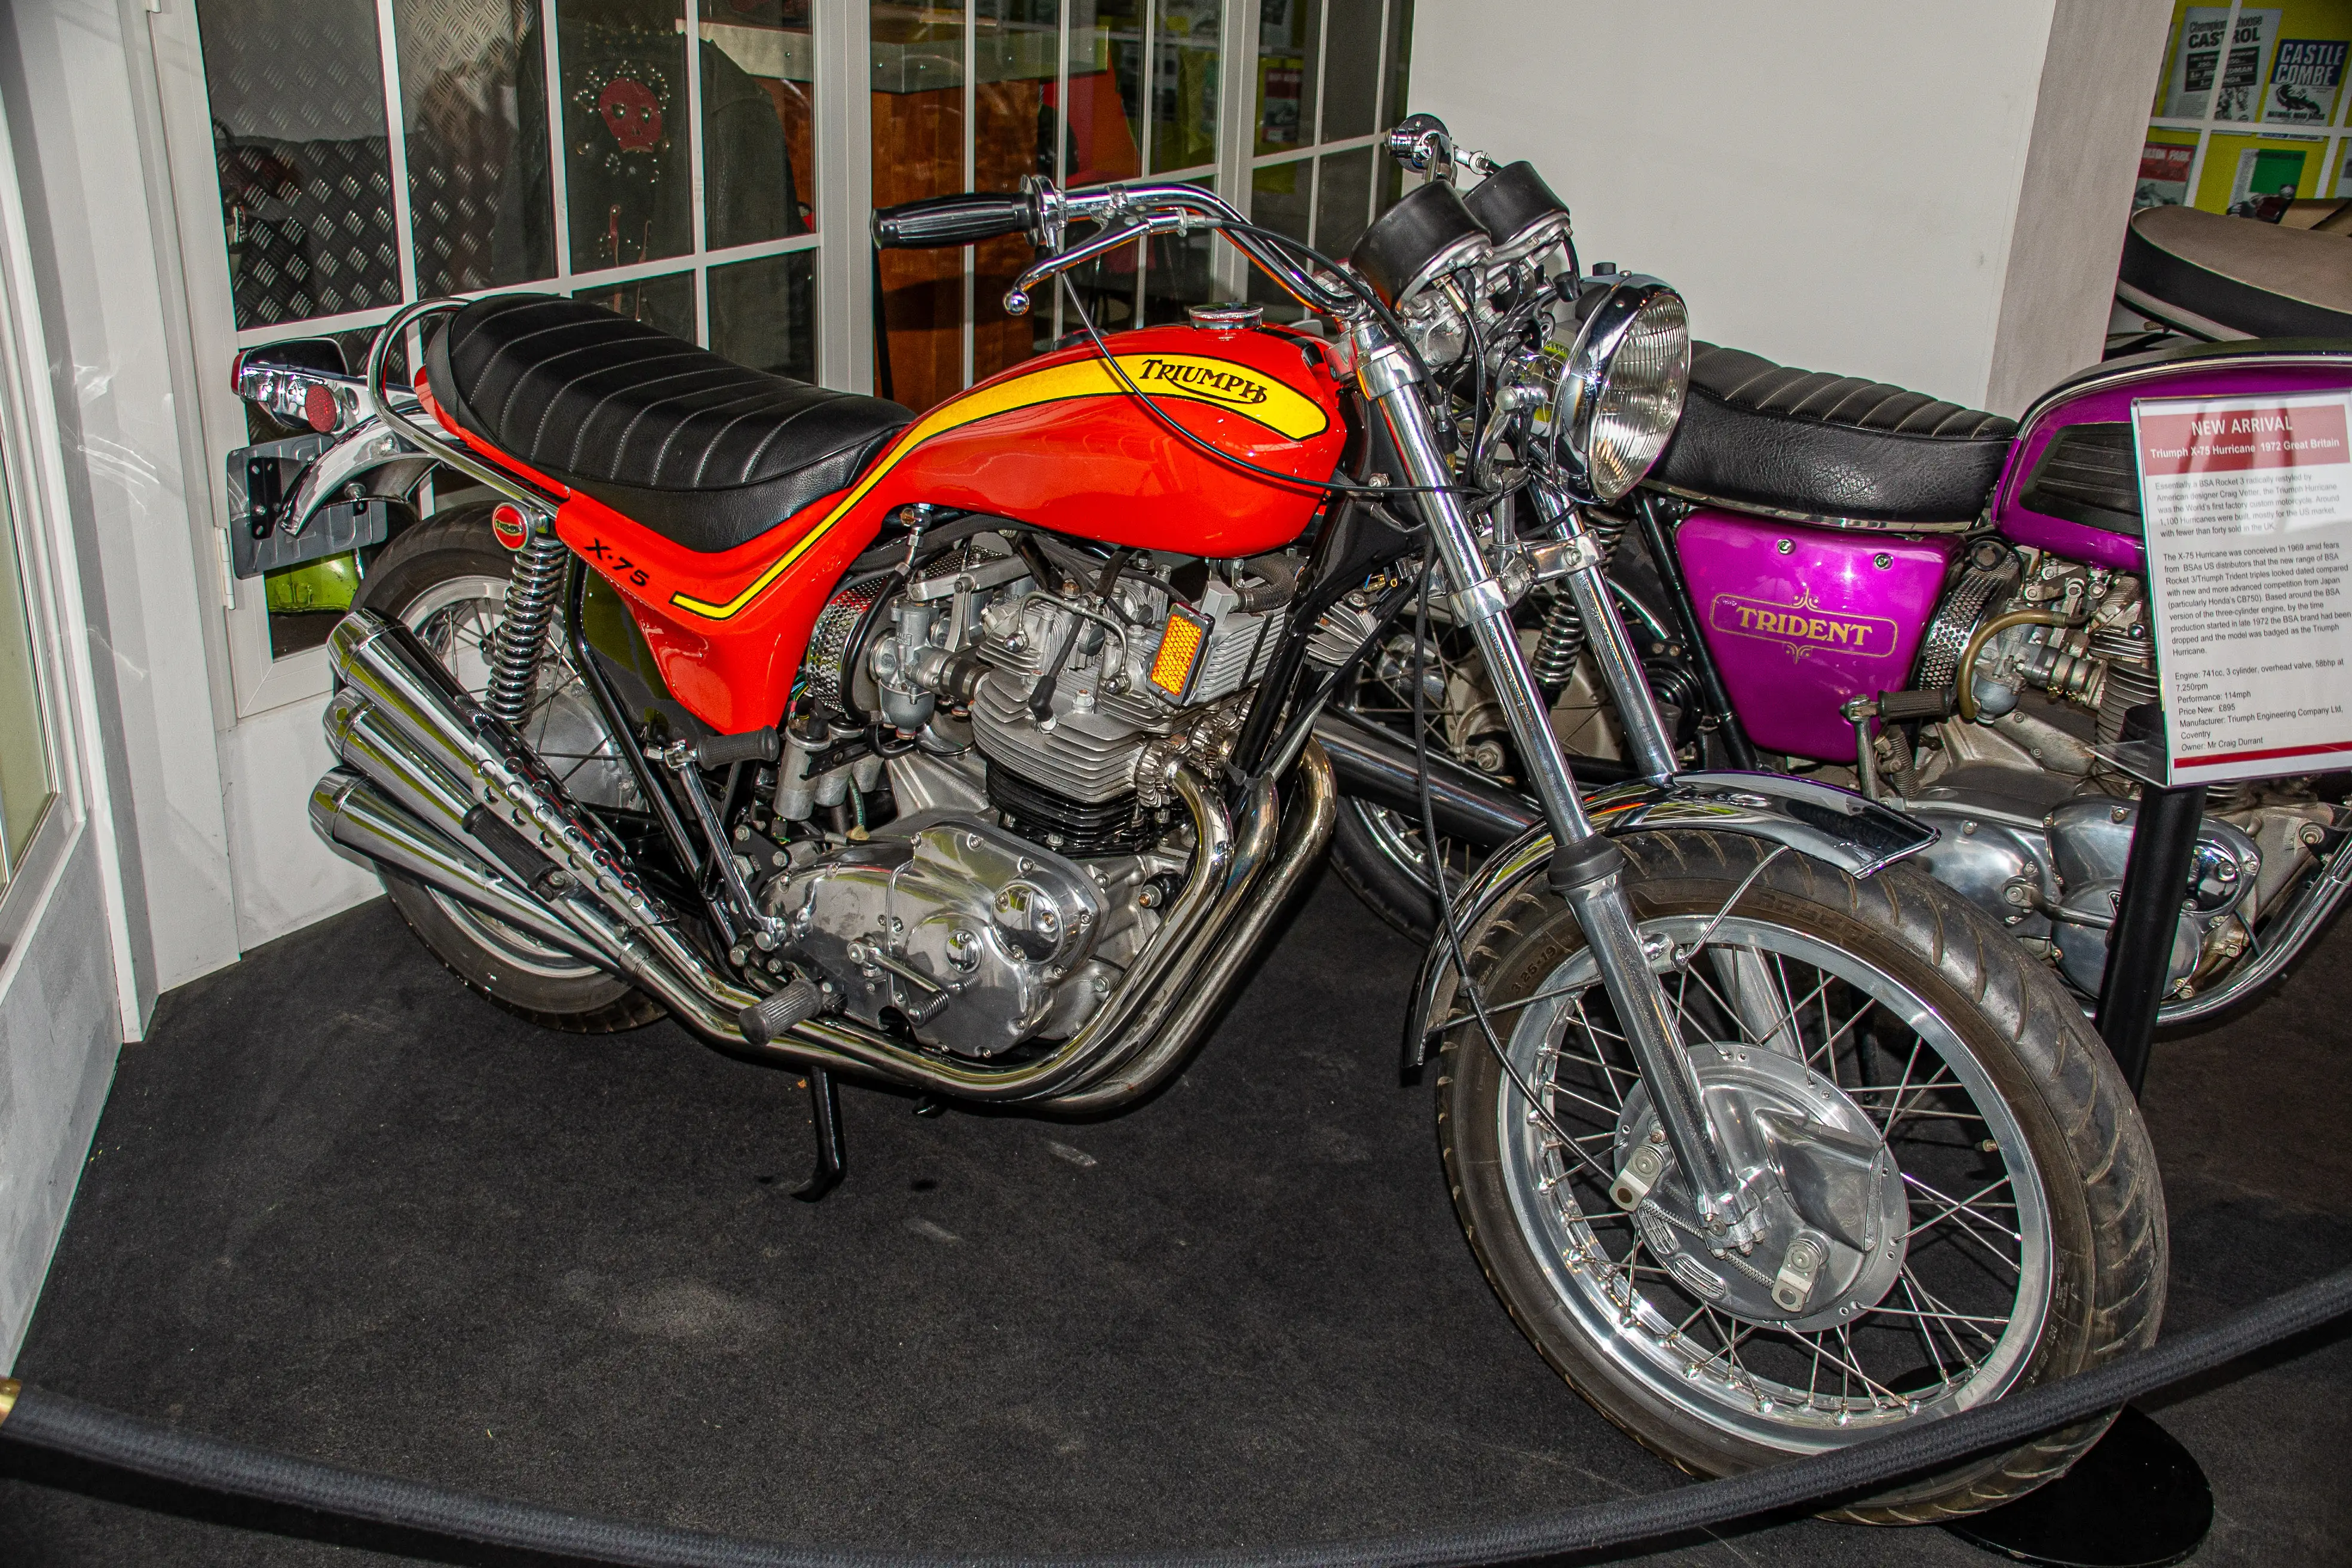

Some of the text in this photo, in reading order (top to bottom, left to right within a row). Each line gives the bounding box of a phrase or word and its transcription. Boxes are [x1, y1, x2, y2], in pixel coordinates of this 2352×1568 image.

[2279, 44, 2345, 65] CASTLE
[2275, 64, 2335, 85] COMBE
[1139, 359, 1267, 404] TRIUMPH
[2191, 415, 2293, 436] NEW ARRIVAL
[2149, 437, 2339, 461] Triumph X-75 Hurricane 1972 Great Britain
[2155, 480, 2191, 491] Essentially
[2199, 479, 2213, 487] BSA
[2215, 477, 2238, 486] Rocket
[2246, 475, 2274, 486] radically
[2275, 473, 2302, 484] restyled
[2304, 473, 2312, 482] by
[2156, 492, 2188, 501] American
[2190, 490, 2218, 501] designer
[2219, 489, 2237, 499] Craig
[2276, 485, 2303, 495] Triumph
[2305, 483, 2337, 492] Hurricane
[2185, 503, 2210, 512] World's
[2212, 501, 2224, 510] first
[2225, 500, 2247, 510] factory
[2315, 494, 2339, 503] Around
[2160, 516, 2178, 526] 1,100
[2180, 514, 2215, 523] Hurricanes
[2252, 510, 2274, 520] mostly
[2175, 527, 2194, 535] fewer
[2195, 526, 2210, 534] than
[2212, 525, 2226, 535] forty
[2251, 522, 2262, 531] the
[2178, 552, 2194, 560] X-75
[2195, 549, 2227, 558] Hurricane
[2243, 546, 2277, 555] conceived
[2287, 543, 2304, 552] 1969
[2305, 542, 2322, 550] amid
[2323, 541, 2339, 549] fears
[2164, 564, 2179, 572] from
[2183, 562, 2202, 571] BSAs
[2216, 559, 2251, 569] distributors
[2295, 556, 2315, 565] range
[2165, 564, 2348, 584] Rocket 3/Triumph Trident triples looked dated compared
[2166, 588, 2180, 596] with
[2198, 586, 2210, 594] and
[2230, 582, 2262, 592] advanced
[2264, 580, 2302, 591] competition
[2303, 577, 2319, 586] from
[2320, 576, 2340, 586] Japan
[2168, 598, 2207, 610] (particularly
[2208, 596, 2235, 605] Honda's
[2265, 592, 2286, 601] Based
[2288, 590, 2312, 599] around
[2325, 587, 2340, 596] BSA
[2169, 612, 2193, 620] version
[2215, 606, 2259, 618] three-cylinder
[2261, 604, 2286, 615] engine,
[2287, 603, 2296, 612] by
[2297, 602, 2308, 610] the
[1736, 606, 1873, 645] TRIDENT
[2170, 622, 2205, 634] production
[2206, 620, 2230, 629] started
[2238, 618, 2250, 627] late
[2253, 617, 2268, 626] 1972
[2283, 614, 2298, 623] BSA
[2300, 613, 2319, 621] brand
[2334, 610, 2351, 618] been
[2172, 635, 2198, 646] dropped
[2200, 633, 2213, 642] and
[2227, 630, 2247, 639] model
[2264, 627, 2289, 638] badged
[2313, 623, 2339, 634] Triumph
[2172, 646, 2207, 656] Hurricane.
[2175, 670, 2200, 681] Engine:
[2202, 668, 2224, 678] 741cc,
[2232, 665, 2259, 676] cylinder,
[2261, 662, 2292, 672] overhead
[2293, 660, 2314, 670] valve,
[2315, 658, 2335, 669] 58bhp
[2176, 681, 2208, 693] 7,250rpm
[2177, 689, 2251, 703] Performance: 114mph
[2178, 703, 2235, 715] Price New: £895
[2179, 705, 2343, 727] Manufacturer: Triumph Engineering Company Ltd,
[2180, 729, 2211, 741] Coventry
[2181, 742, 2205, 751] Owner:
[2218, 738, 2236, 749] Craig
[2238, 736, 2263, 745] Durrant
